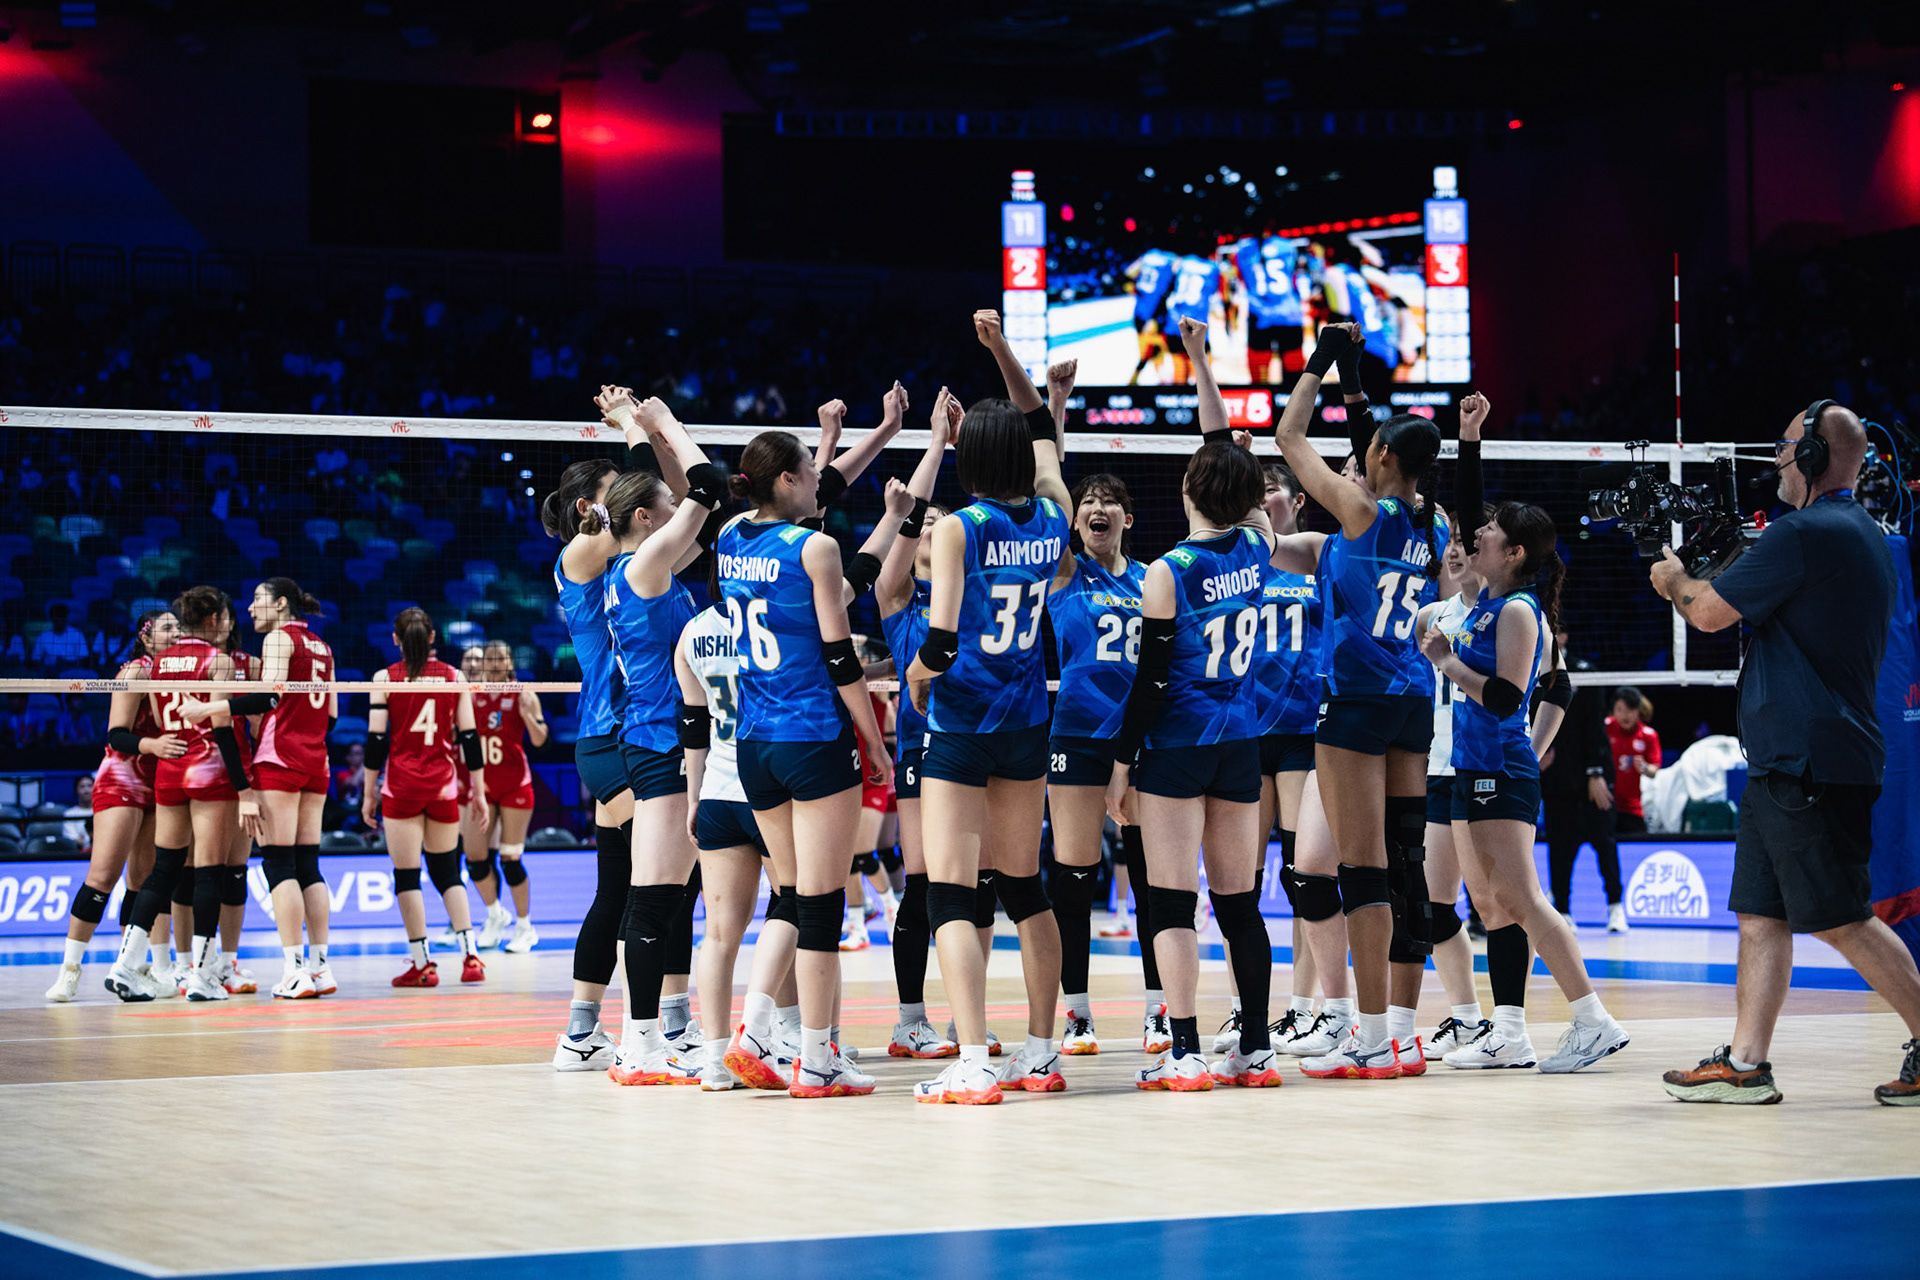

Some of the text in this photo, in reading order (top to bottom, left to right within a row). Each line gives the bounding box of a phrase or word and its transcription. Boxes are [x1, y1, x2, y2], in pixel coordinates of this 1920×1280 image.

[1011, 211, 1035, 237] 11
[1432, 207, 1461, 234] 15
[1011, 256, 1037, 288] 2
[1434, 259, 1460, 285] 3
[984, 536, 1061, 567] AKIMOTO
[1401, 538, 1432, 567] AIR
[718, 552, 780, 583] YOSHINO
[1202, 563, 1260, 603] SHIODE
[1092, 593, 1142, 609] CAPCO
[1263, 587, 1314, 598] APCOM
[1372, 571, 1426, 640] 15
[980, 578, 1048, 655] 33
[1260, 603, 1303, 652] 11
[693, 635, 739, 659] NISHI
[727, 595, 781, 671] 26
[1096, 613, 1143, 665] 28
[1203, 606, 1258, 679] 18
[309, 658, 326, 709] 5
[410, 698, 438, 746] 4
[705, 674, 740, 741] 3
[906, 766, 915, 785] 6
[1051, 753, 1067, 772] 28
[1475, 781, 1495, 790] TEL
[1643, 863, 1690, 884] 百岁山
